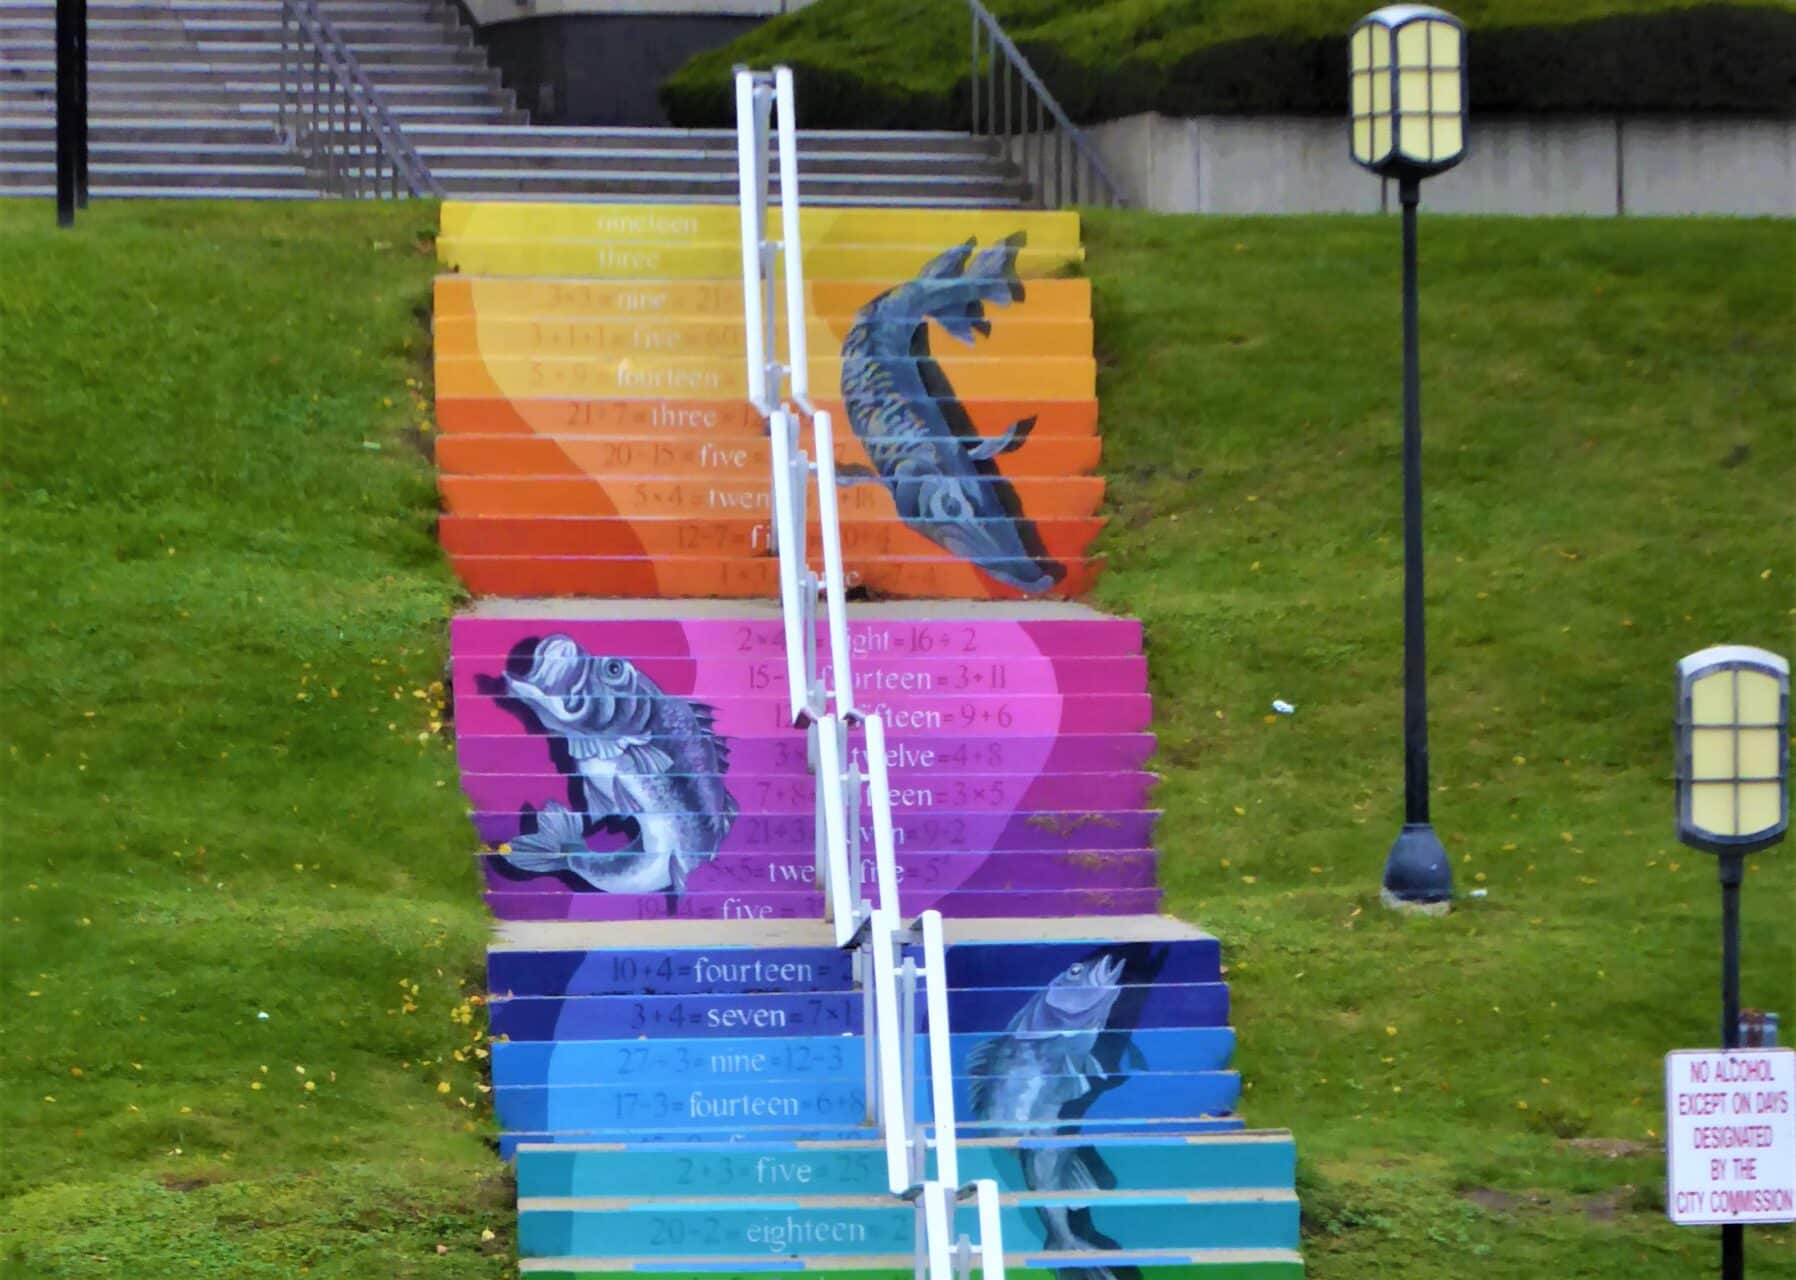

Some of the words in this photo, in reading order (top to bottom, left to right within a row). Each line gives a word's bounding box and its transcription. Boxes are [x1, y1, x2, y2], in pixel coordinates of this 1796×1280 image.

[616, 360, 719, 389] fourteen
[651, 404, 718, 429] three
[699, 442, 749, 468] five
[706, 487, 771, 510] twen
[846, 625, 890, 659] ight
[821, 663, 932, 692] frteen
[693, 956, 813, 983] fourteen
[706, 1006, 787, 1029] seven
[711, 1047, 767, 1074] nine
[1690, 1060, 1708, 1083] NO
[1715, 1059, 1775, 1083] ALCOHOL
[689, 1091, 800, 1119] fourteen
[1679, 1092, 1727, 1115] EXCEPT
[1732, 1092, 1751, 1114] ON
[1756, 1090, 1788, 1114] DAYS
[1694, 1125, 1773, 1149] DESIGNATED
[755, 1155, 813, 1184] five
[1711, 1158, 1727, 1181] BY
[1732, 1157, 1757, 1180] THE
[1676, 1191, 1704, 1214] CITY
[1711, 1189, 1793, 1213] COMMISSION
[745, 1214, 867, 1250] eighteen
